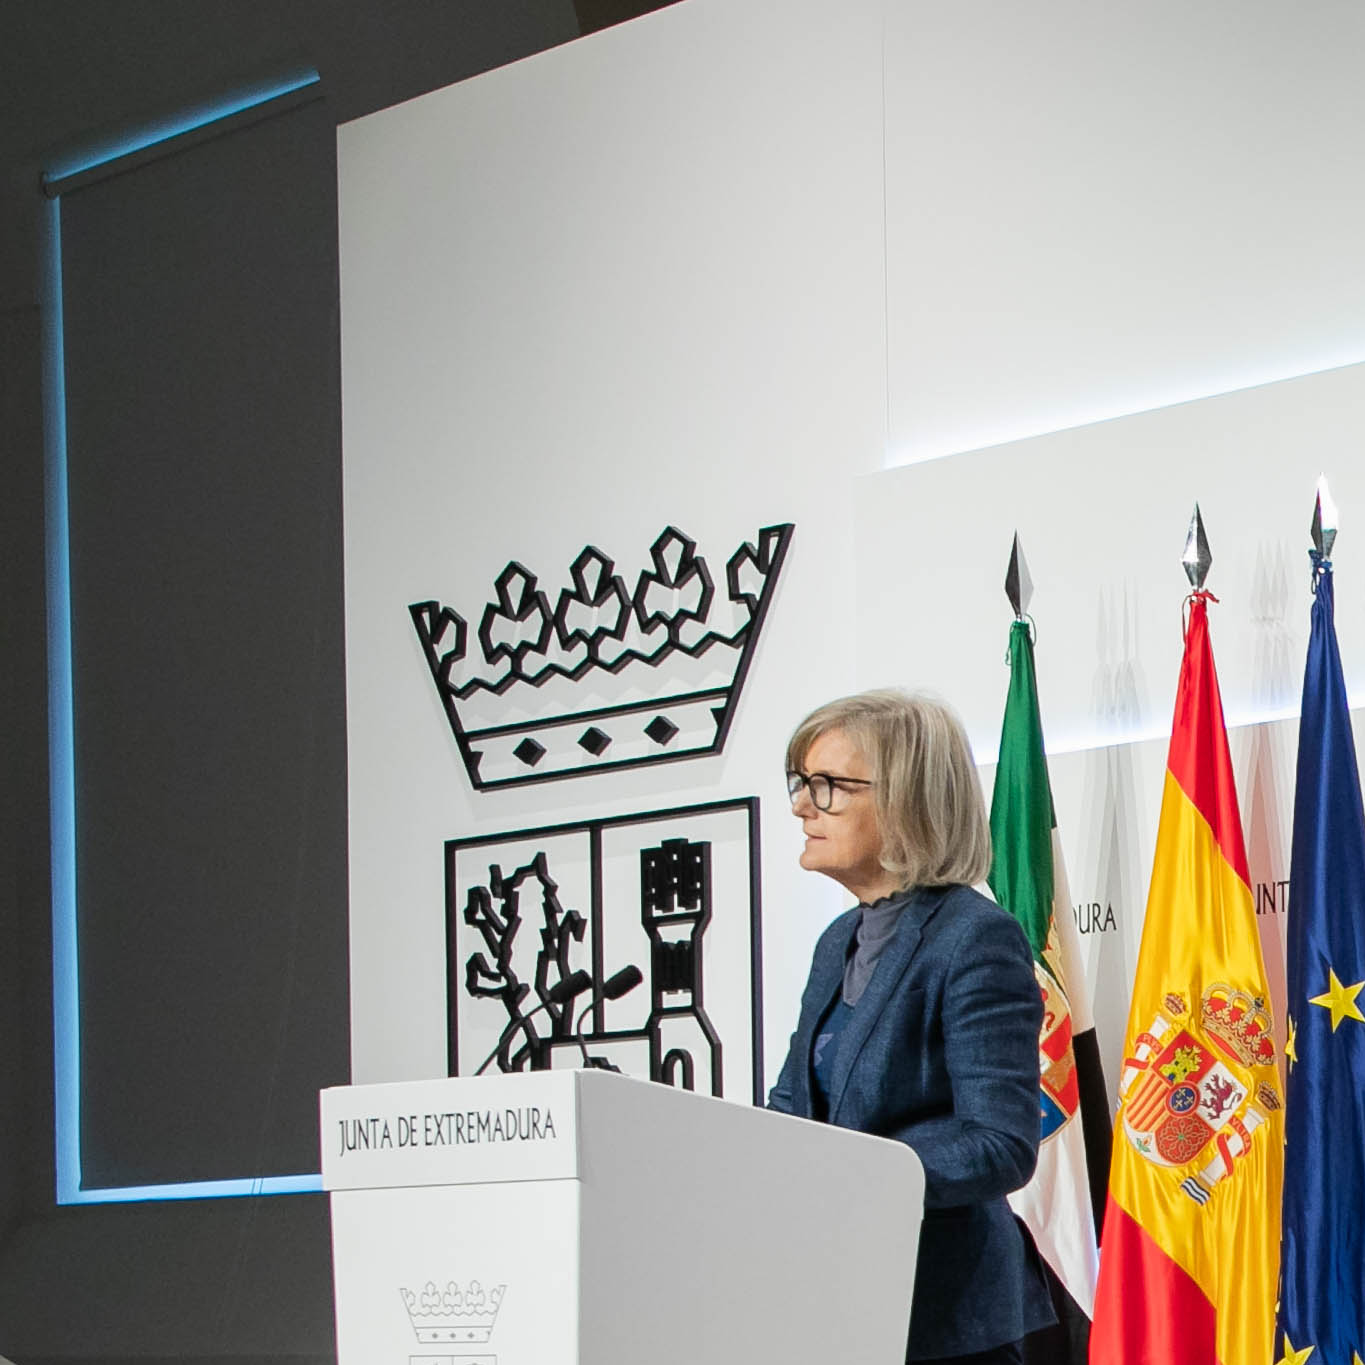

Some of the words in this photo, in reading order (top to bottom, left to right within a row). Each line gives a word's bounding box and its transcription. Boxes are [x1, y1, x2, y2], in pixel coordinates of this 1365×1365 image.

[339, 1118, 393, 1157] JUNTA
[398, 1115, 418, 1148] DE
[424, 1106, 557, 1146] EXTREMADURA
